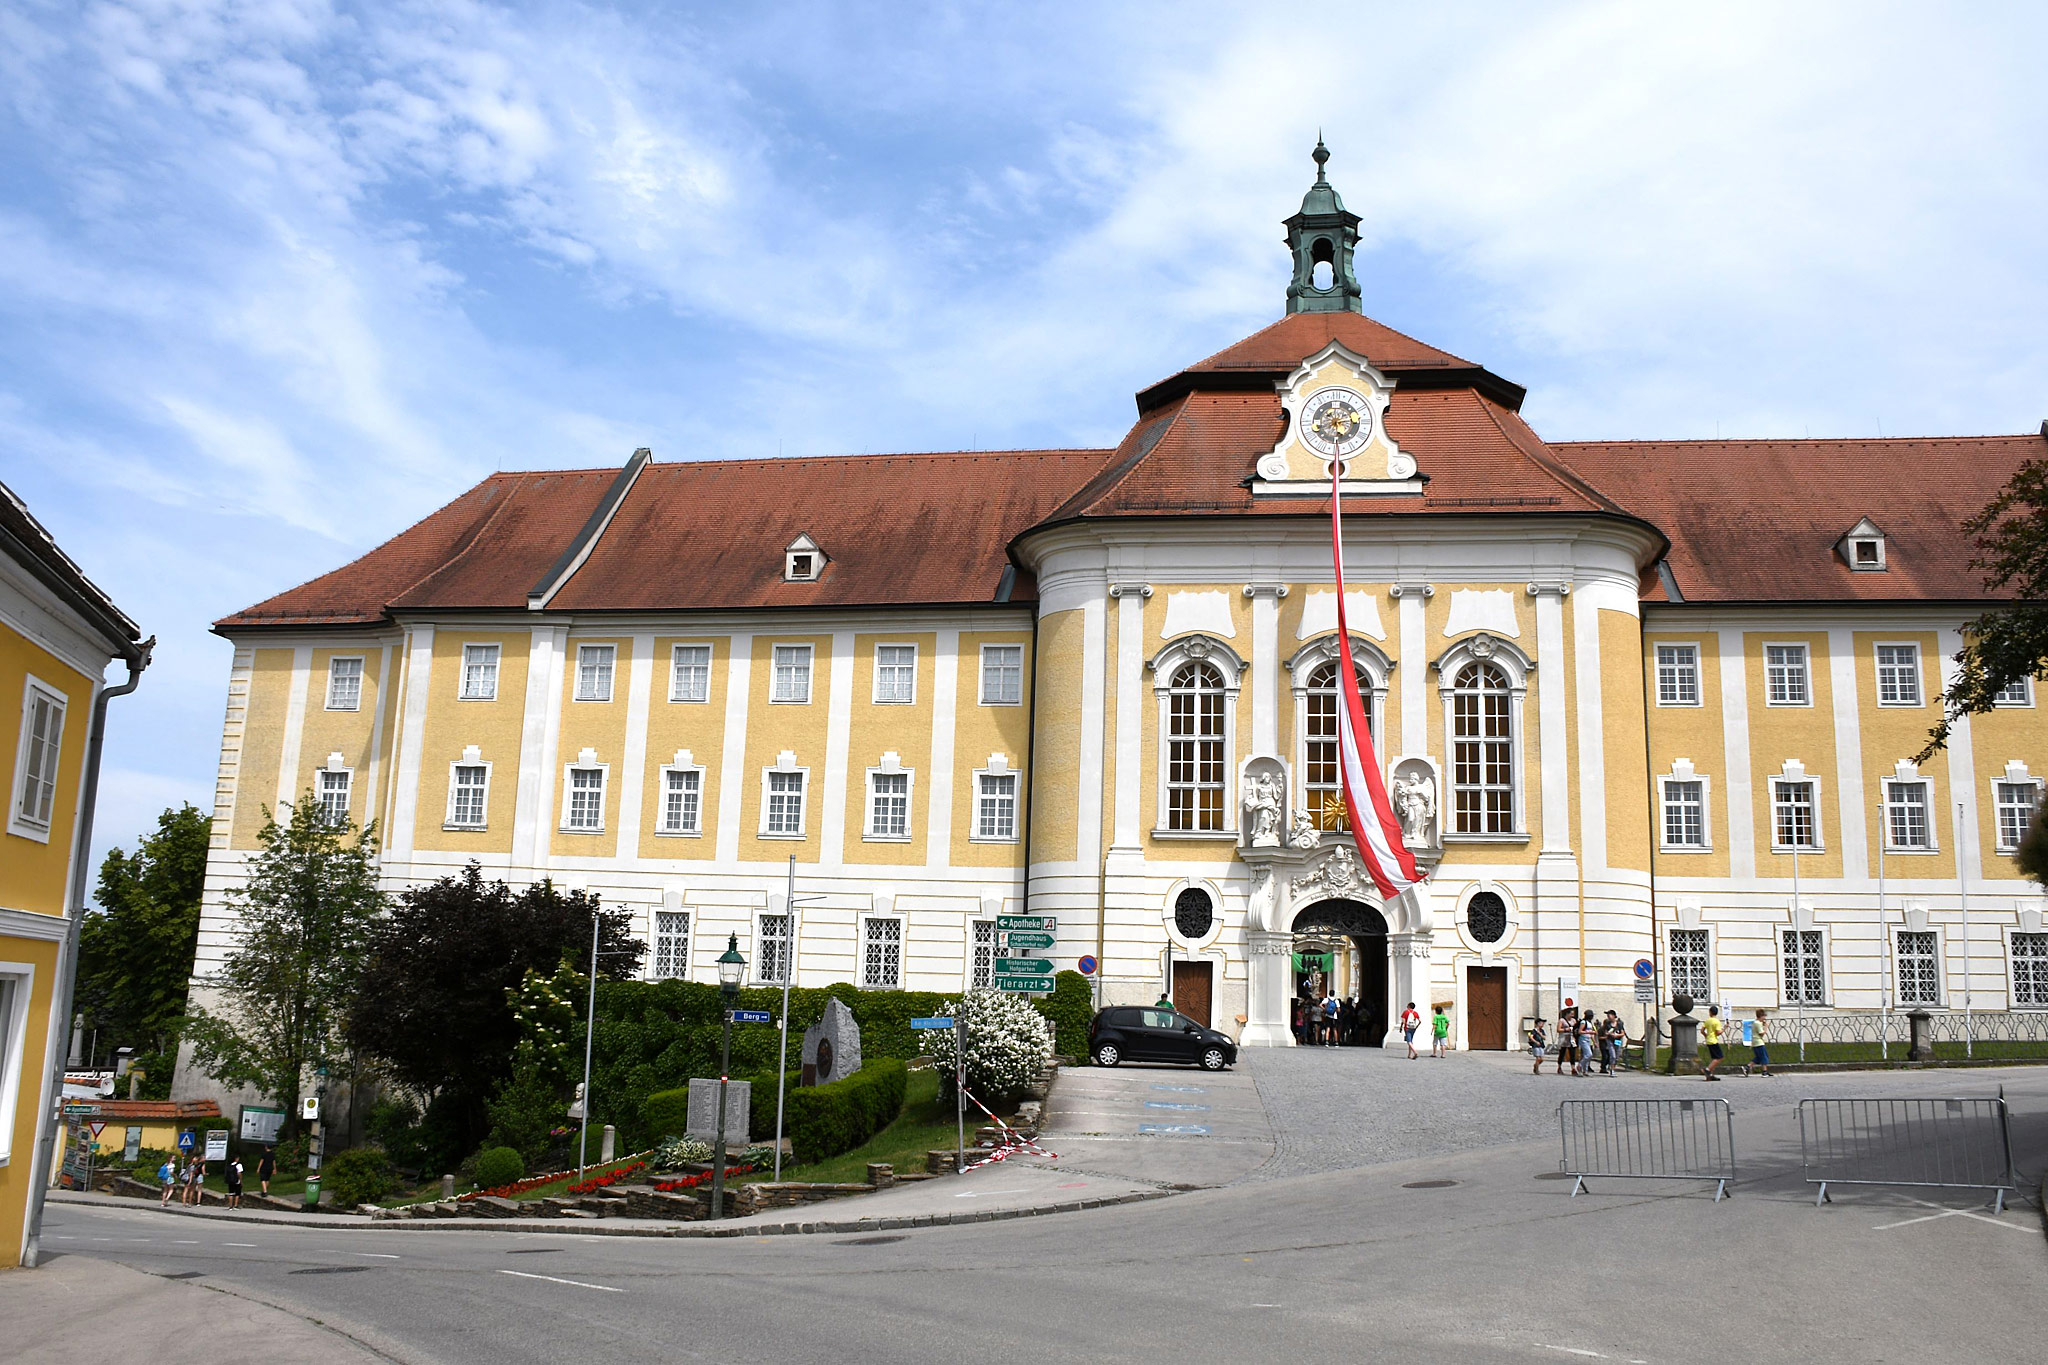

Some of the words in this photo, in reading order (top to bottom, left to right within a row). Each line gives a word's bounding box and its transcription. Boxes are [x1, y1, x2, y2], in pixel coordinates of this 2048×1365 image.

[1008, 918, 1040, 929] Apotheke
[1010, 934, 1046, 942] Jugendhaus
[997, 978, 1038, 988] Tierarzt
[744, 1012, 760, 1020] Berg
